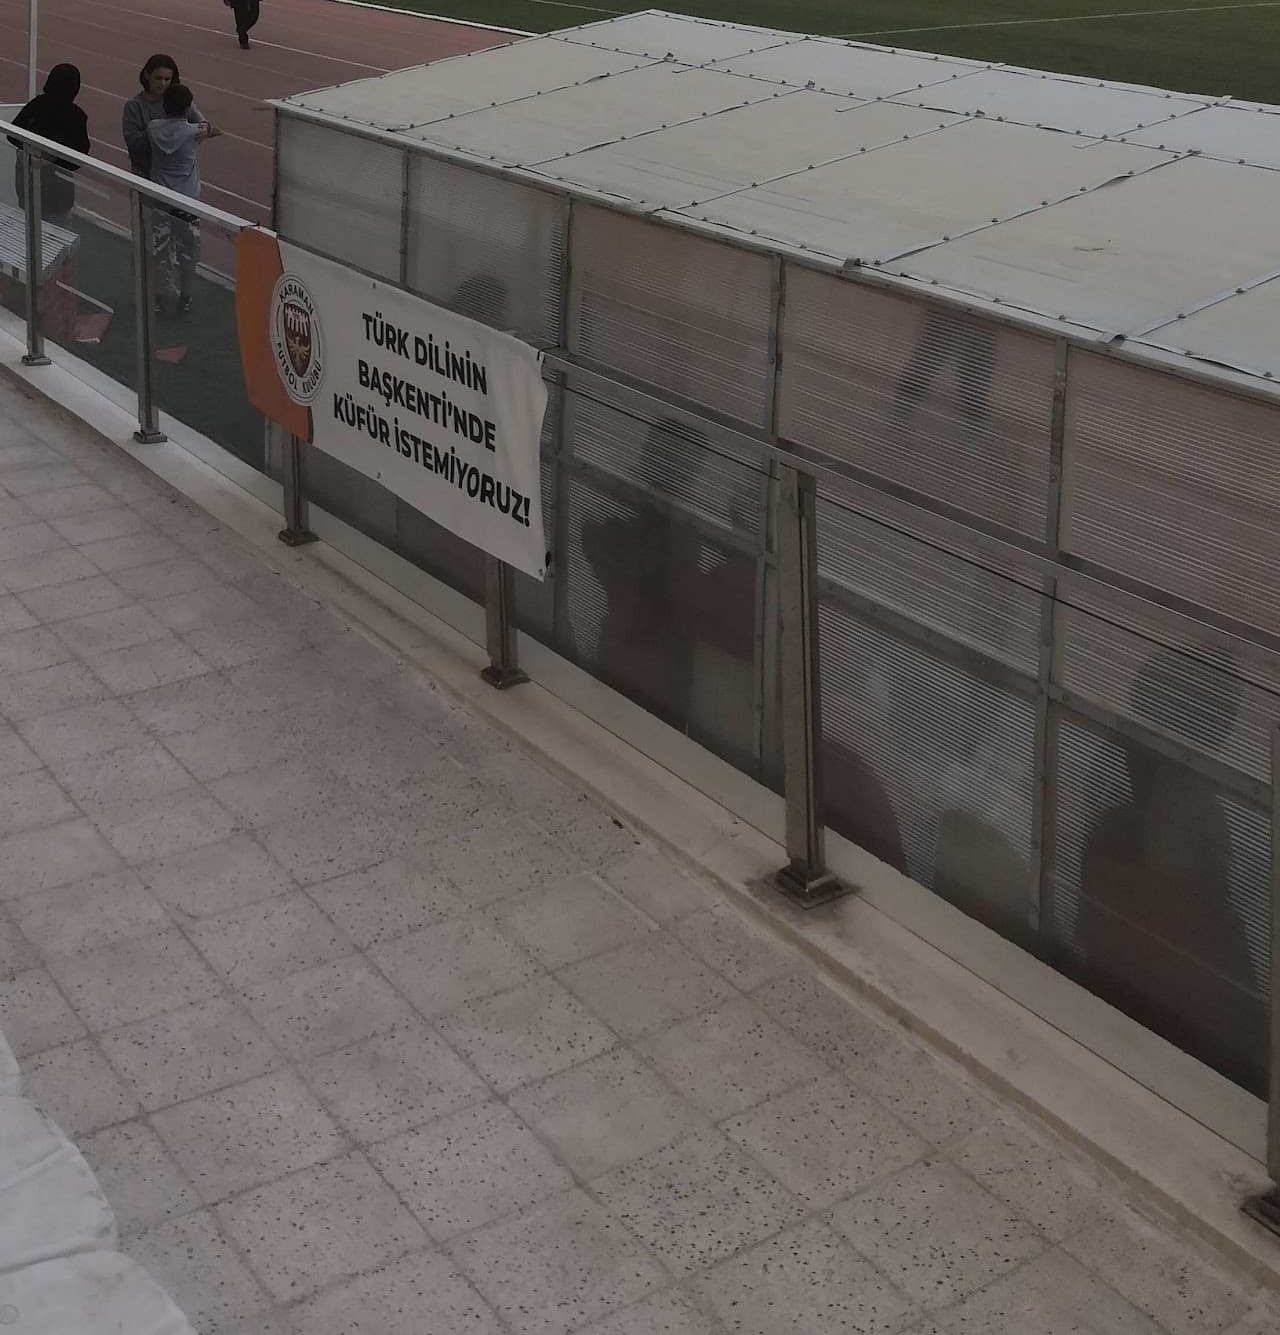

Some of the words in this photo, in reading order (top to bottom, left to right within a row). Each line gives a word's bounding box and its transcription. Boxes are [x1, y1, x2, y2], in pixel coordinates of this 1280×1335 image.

[279, 284, 314, 315] KARAMAN
[277, 342, 299, 391] FUTBOL
[362, 312, 410, 359] TÜRK
[415, 334, 487, 395] DİLİNİN
[358, 359, 496, 453] BAŞKENTİ'NDE
[334, 393, 391, 447] KÜFÜR
[394, 417, 531, 527] İSTEMİYORUZ!
